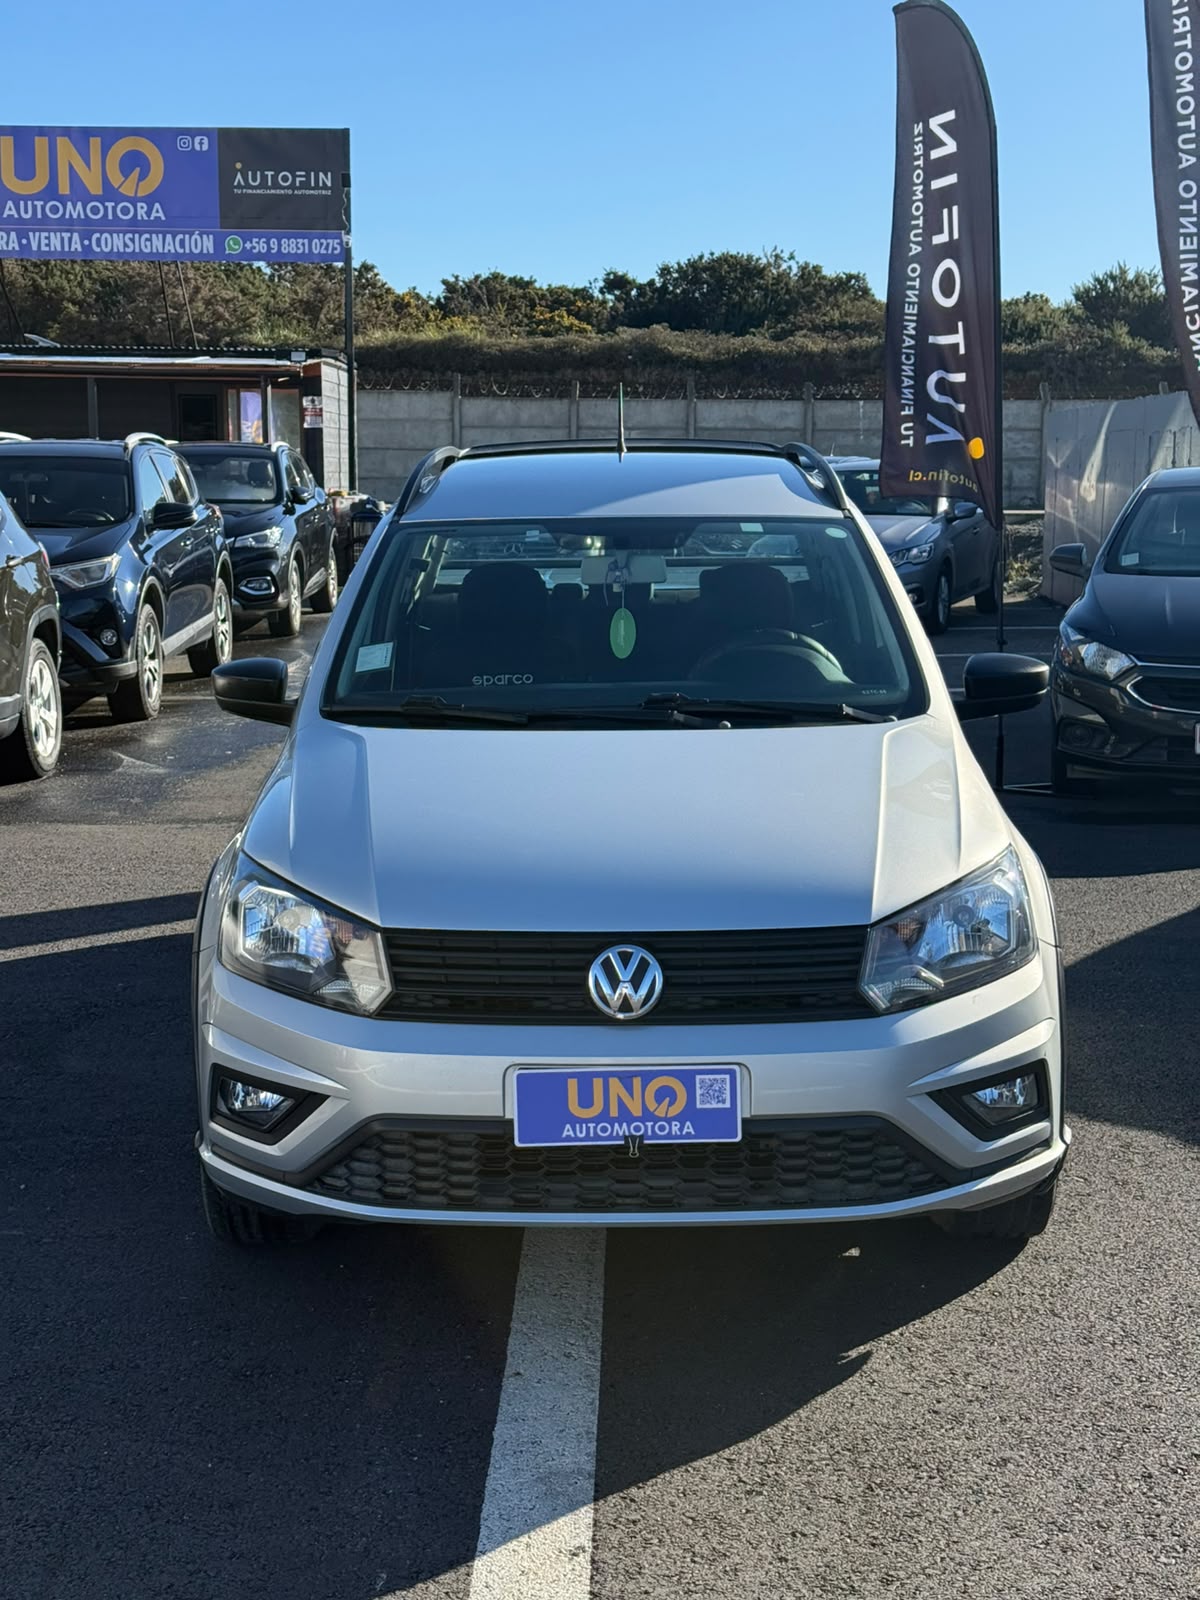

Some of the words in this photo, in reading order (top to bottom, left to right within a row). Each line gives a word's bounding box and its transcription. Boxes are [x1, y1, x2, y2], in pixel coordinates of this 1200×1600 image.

[0, 136, 165, 197] UNO
[233, 170, 332, 187] AUTOFIN
[3, 200, 166, 220] AUTOMOTORA
[244, 238, 267, 253] +56
[270, 238, 278, 253] 9
[281, 238, 309, 253] 8831
[312, 239, 340, 254] 0275
[472, 674, 534, 687] sparco
[567, 1076, 687, 1118] UNO
[562, 1121, 695, 1138] AUTOMOTORA
